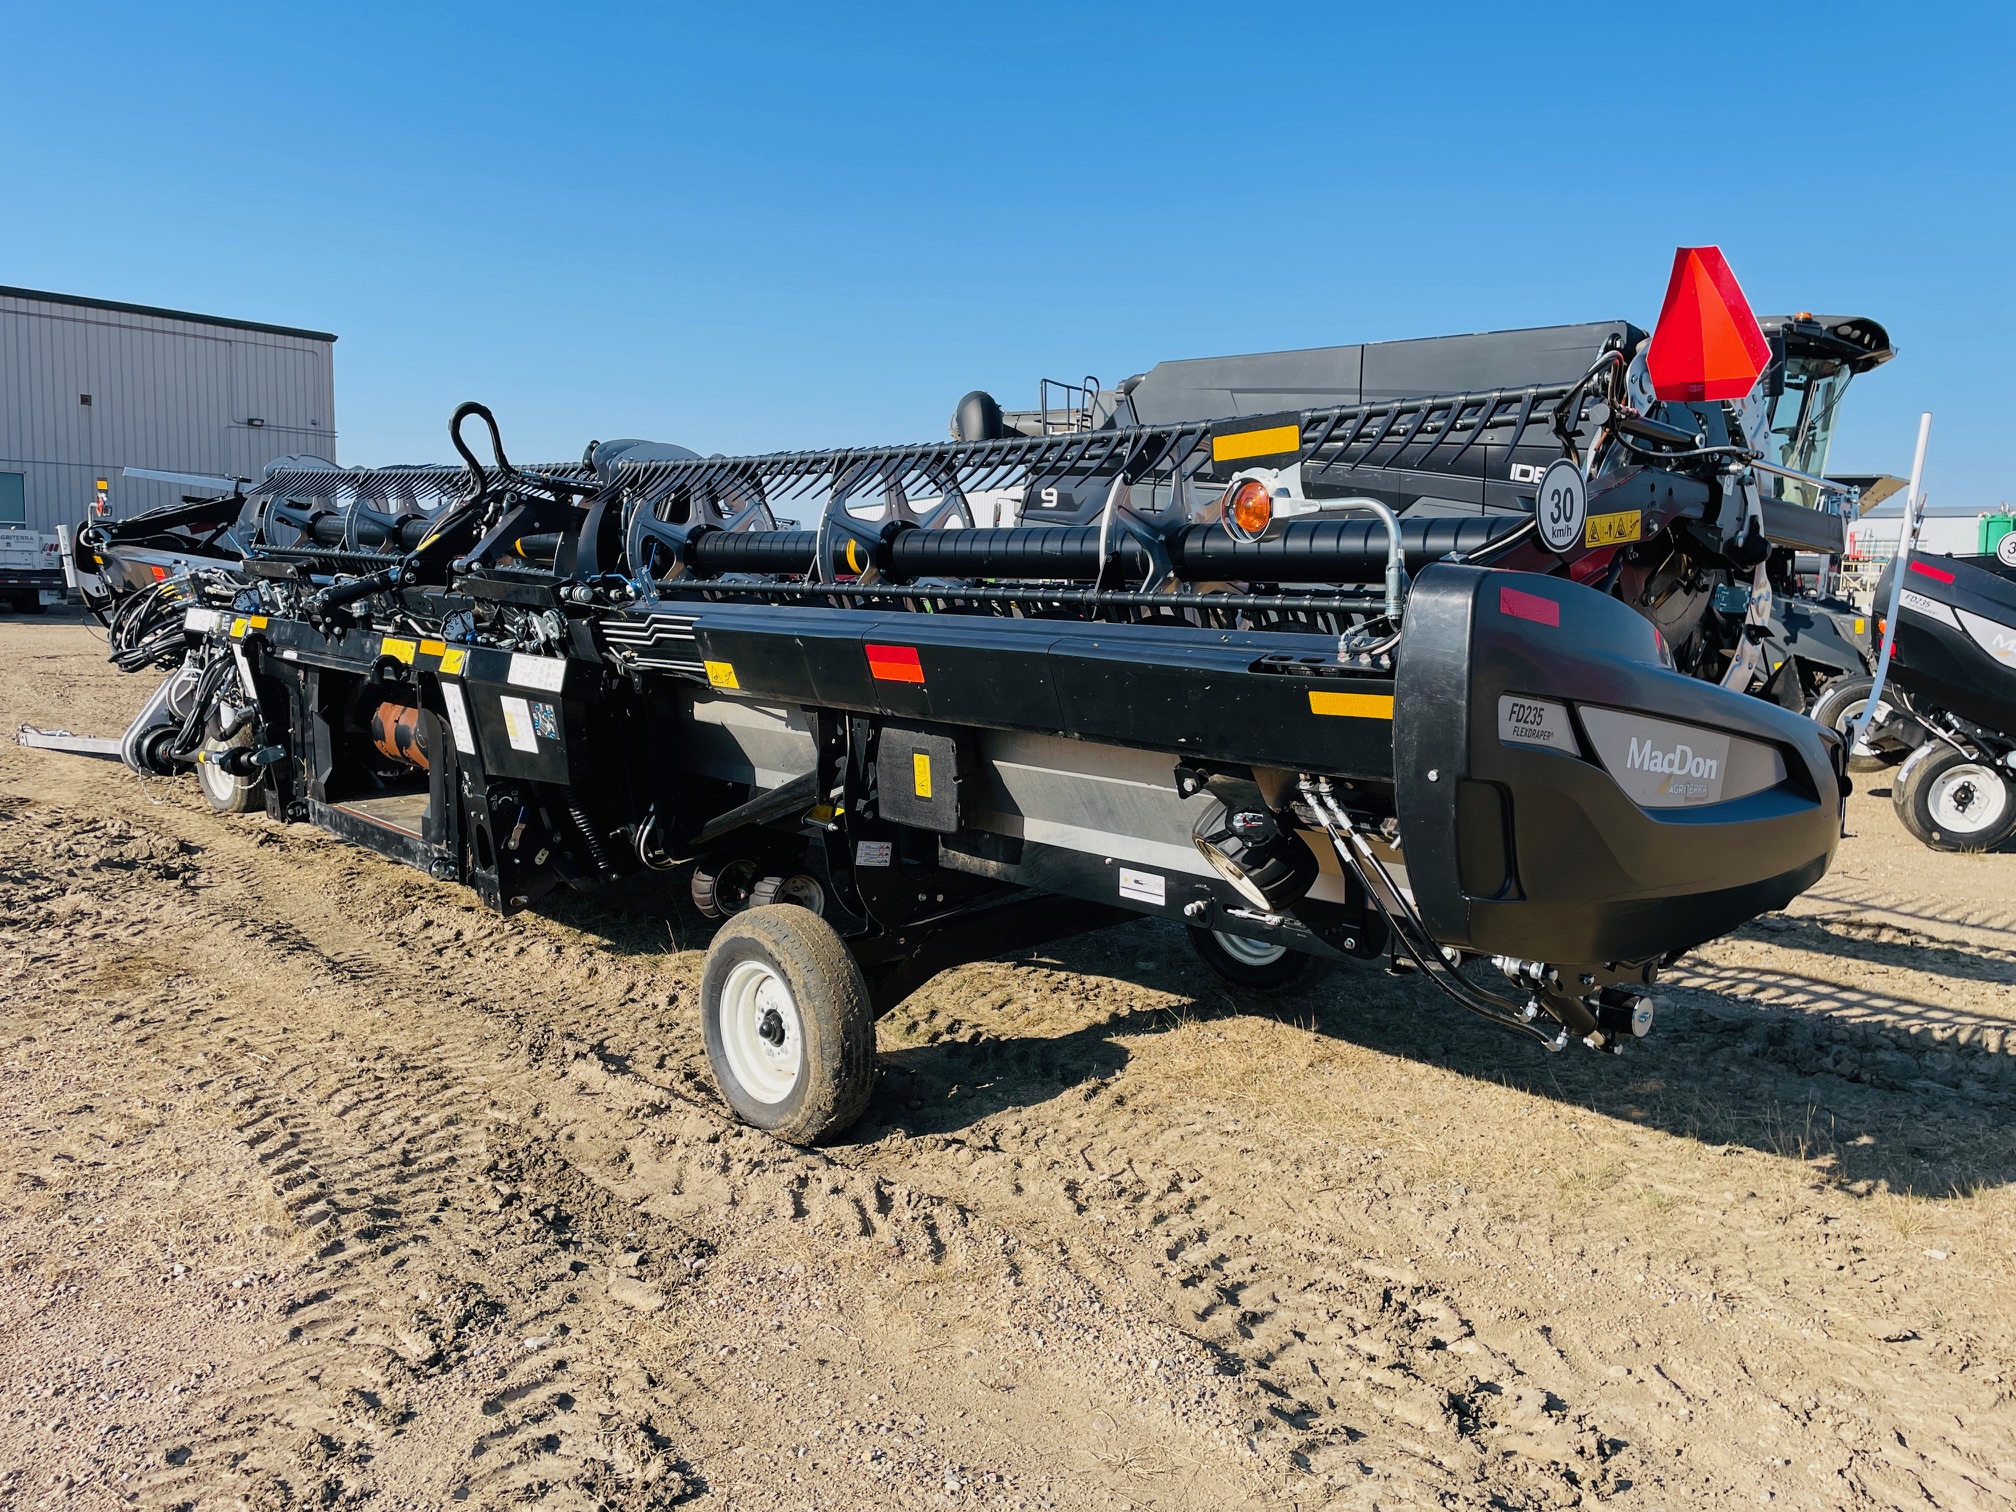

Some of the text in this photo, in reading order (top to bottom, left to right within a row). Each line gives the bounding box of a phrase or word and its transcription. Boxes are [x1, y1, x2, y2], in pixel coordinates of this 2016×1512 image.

[1509, 462, 1547, 484] IDE
[1041, 487, 1058, 508] 9
[1550, 487, 1574, 525] 30
[1551, 524, 1572, 539] km/h
[2008, 541, 2016, 555] 3
[1905, 593, 1931, 608] FD235
[1508, 702, 1545, 727] FD235
[1626, 736, 1718, 780] MacDon
